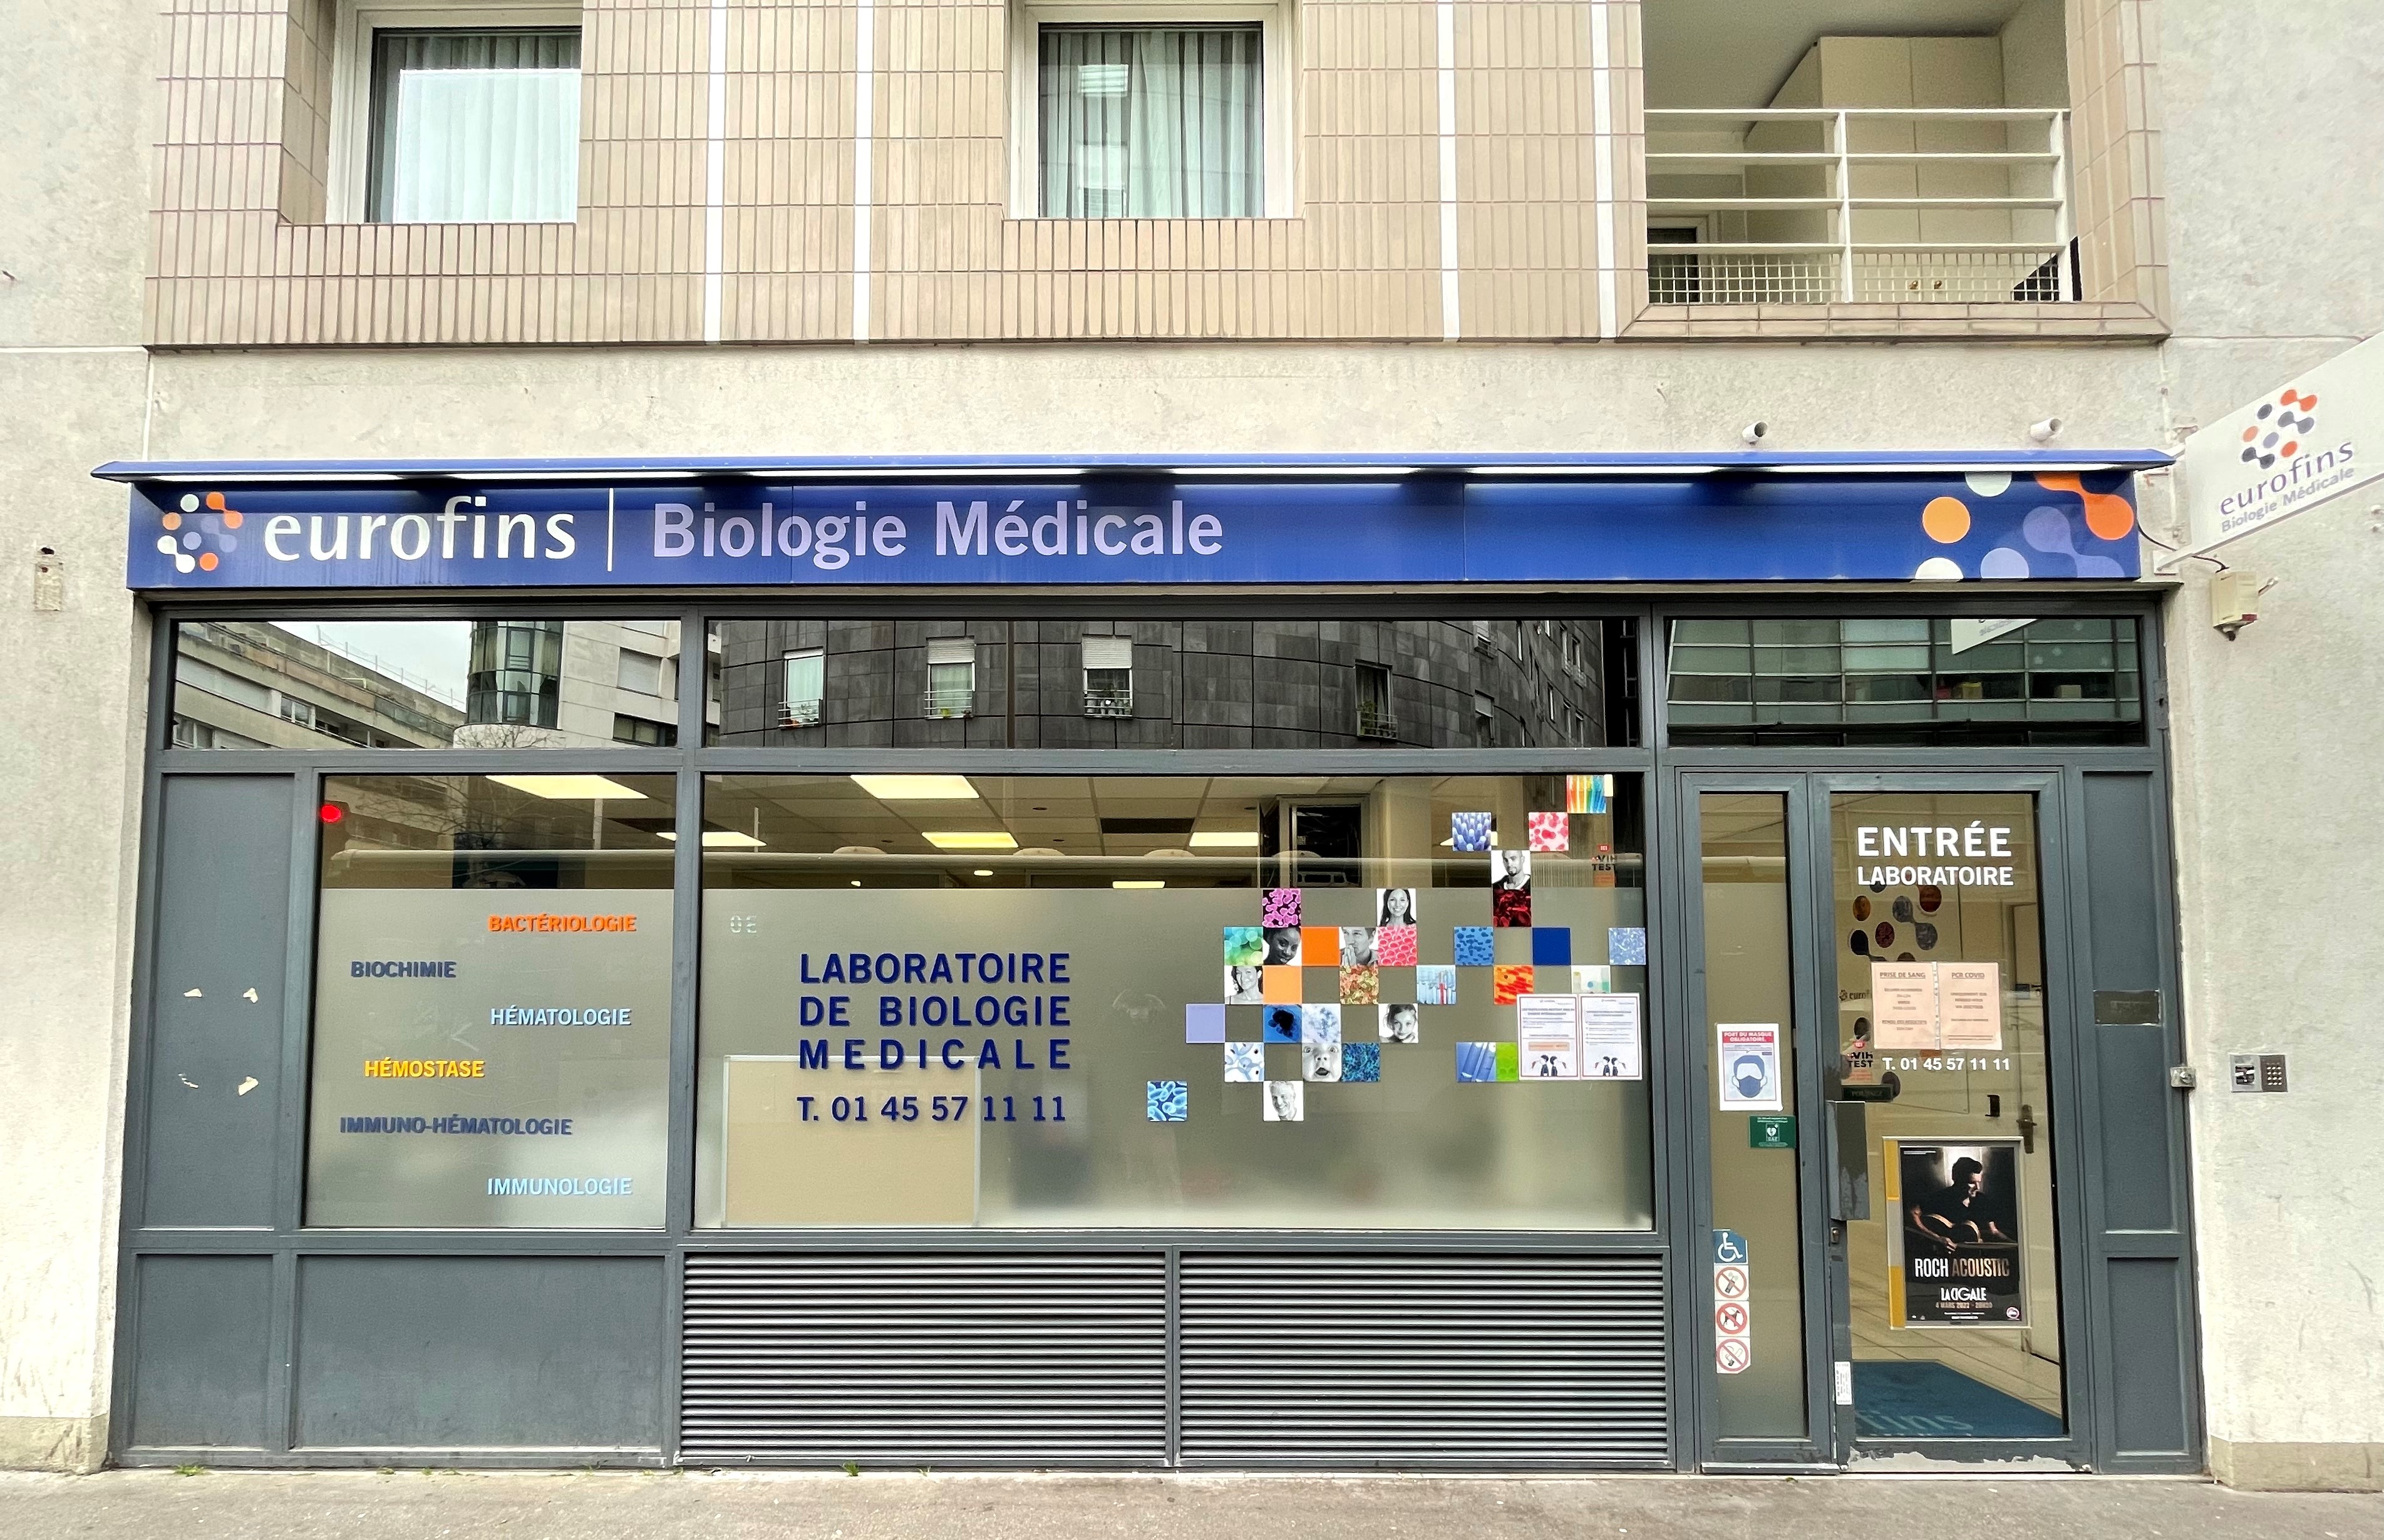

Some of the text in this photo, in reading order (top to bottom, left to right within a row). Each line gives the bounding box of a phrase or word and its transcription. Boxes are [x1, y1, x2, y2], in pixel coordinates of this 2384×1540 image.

[2221, 442, 2353, 515] eurofins
[2221, 468, 2355, 532] Biologie Médicale
[264, 495, 1223, 570] eurofins Biologie Médicale
[1857, 820, 2012, 857] ENTRÉE
[1858, 866, 2014, 886] LABORATOIRE
[488, 912, 637, 933] BACTÉRIOLOGIE
[351, 961, 457, 978] BIOCHIMIE
[800, 953, 1071, 983] LABORATOIRE
[490, 1005, 631, 1026] HÉMATOLOGIE
[799, 996, 1071, 1026] DE BIOLOGIE
[799, 1039, 1071, 1070] MEDICALE
[1882, 1058, 2010, 1070] T. 01 45 57 11 11
[364, 1058, 485, 1078] HÉMOSTASE
[797, 1096, 1066, 1122] T. 01 45 57 11 11
[340, 1114, 572, 1135] IMMUNO-HÉMATOLOGIE
[487, 1177, 632, 1196] IMMUNOLOGIE
[1914, 1258, 2010, 1277] ROCH ACOUSTIC
